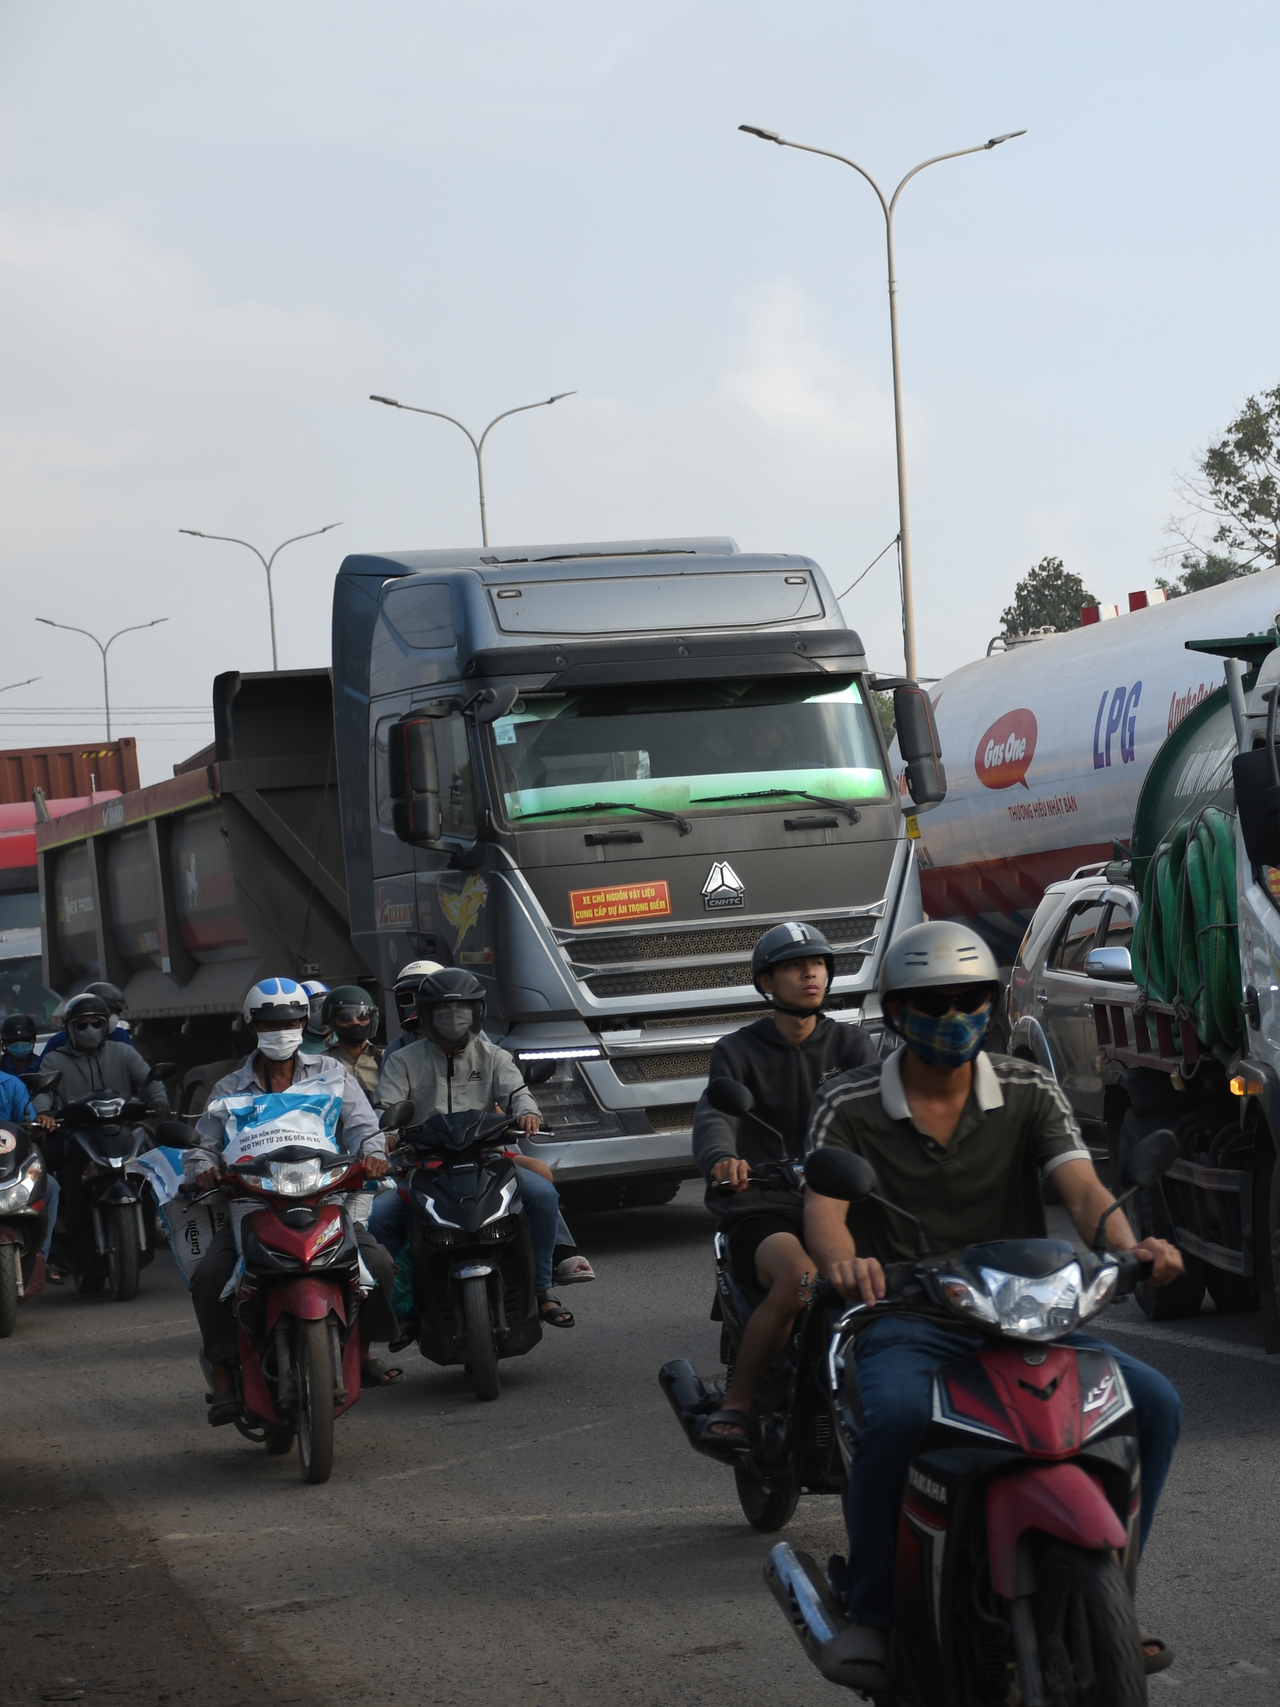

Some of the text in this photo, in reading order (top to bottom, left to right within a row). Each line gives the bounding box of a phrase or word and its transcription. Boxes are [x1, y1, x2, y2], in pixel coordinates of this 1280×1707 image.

[1093, 680, 1142, 770] LPG
[984, 732, 1027, 769] Gas One
[1047, 795, 1063, 818] NHẬT
[1065, 791, 1078, 814] BẢN
[582, 895, 591, 905] XE
[592, 891, 605, 904] CHỞ
[629, 888, 641, 900] VẬT
[641, 886, 656, 899] LIỆU
[709, 897, 741, 906] CNHTC
[575, 909, 593, 919] CUNG
[594, 904, 607, 917] CẤP
[618, 903, 627, 914] ÁN
[628, 902, 649, 914] TRỌNG
[240, 1143, 251, 1153] HEO
[251, 1140, 265, 1148] THỊT
[188, 1219, 202, 1256] Cargill
[909, 1465, 948, 1505] YAMAHA
